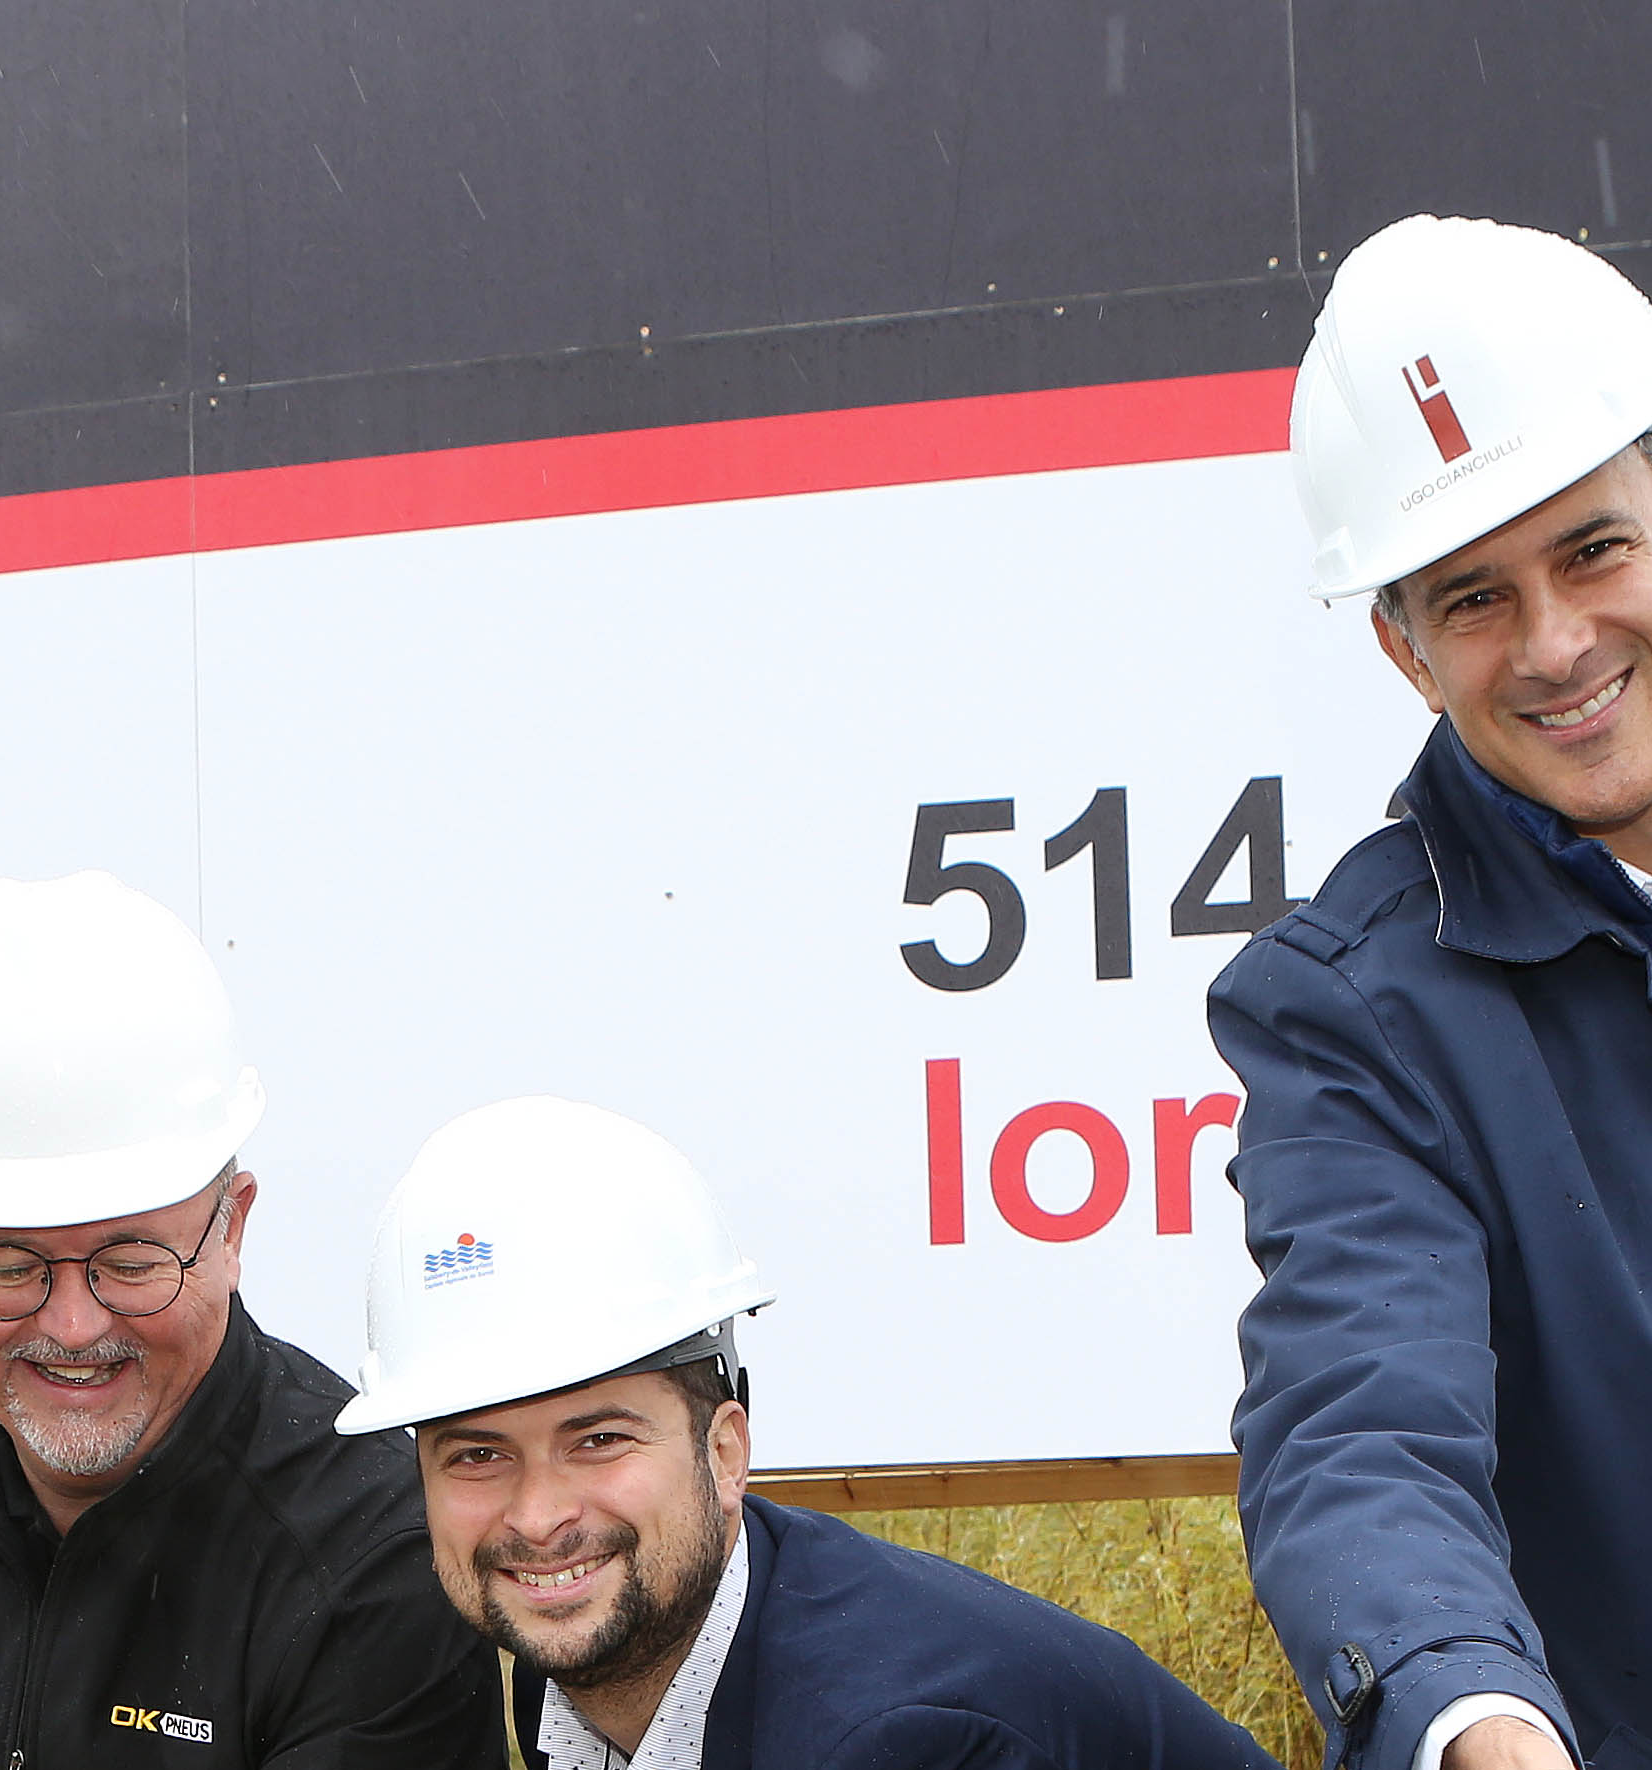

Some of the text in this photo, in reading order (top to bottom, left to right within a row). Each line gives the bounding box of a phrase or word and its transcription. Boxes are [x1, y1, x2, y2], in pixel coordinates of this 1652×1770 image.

[1400, 435, 1523, 512] UGO CIANCIULLI
[899, 775, 1311, 992] 514
[110, 1705, 210, 1741] OK PNEUS
